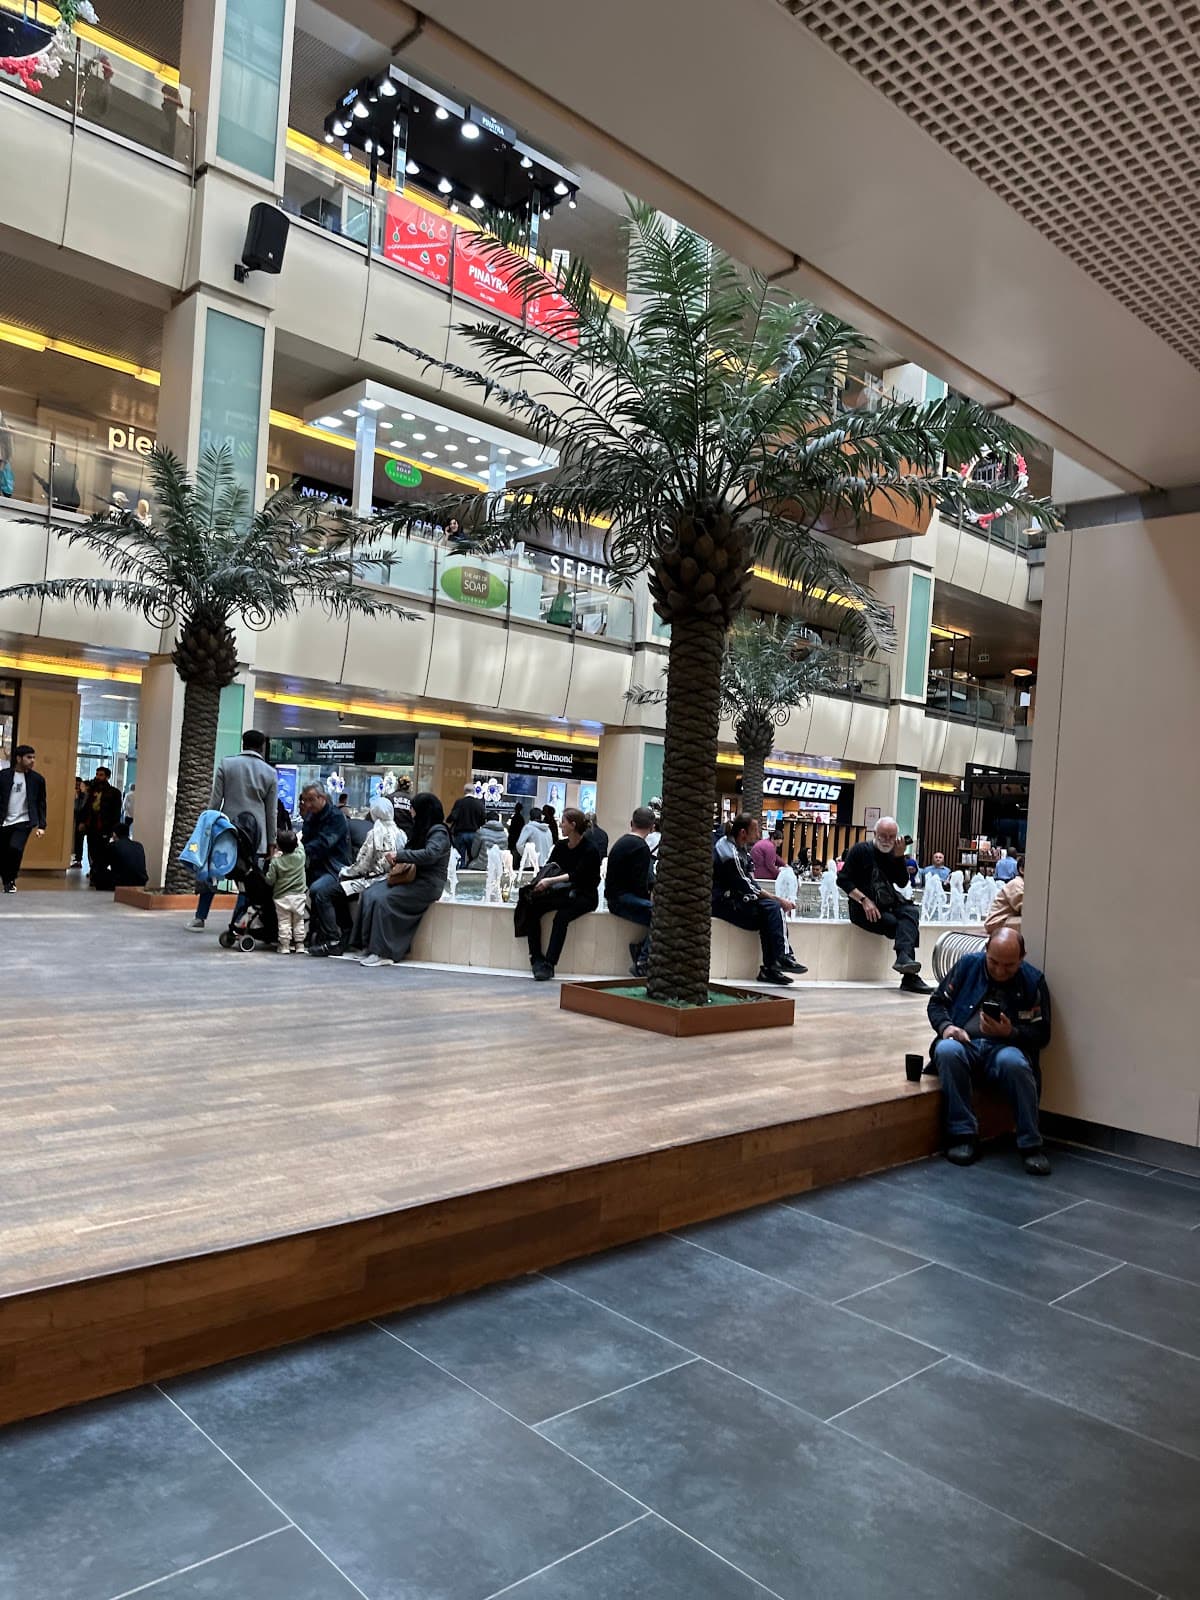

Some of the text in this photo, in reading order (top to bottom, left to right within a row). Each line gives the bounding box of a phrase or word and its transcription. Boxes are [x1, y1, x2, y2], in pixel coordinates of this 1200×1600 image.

[482, 116, 505, 136] PINAYRA
[468, 264, 509, 294] PINAYRA
[396, 465, 411, 475] SOAP
[463, 579, 487, 593] SOAP
[516, 747, 573, 764] blue diamond
[763, 777, 841, 801] KECHERS
